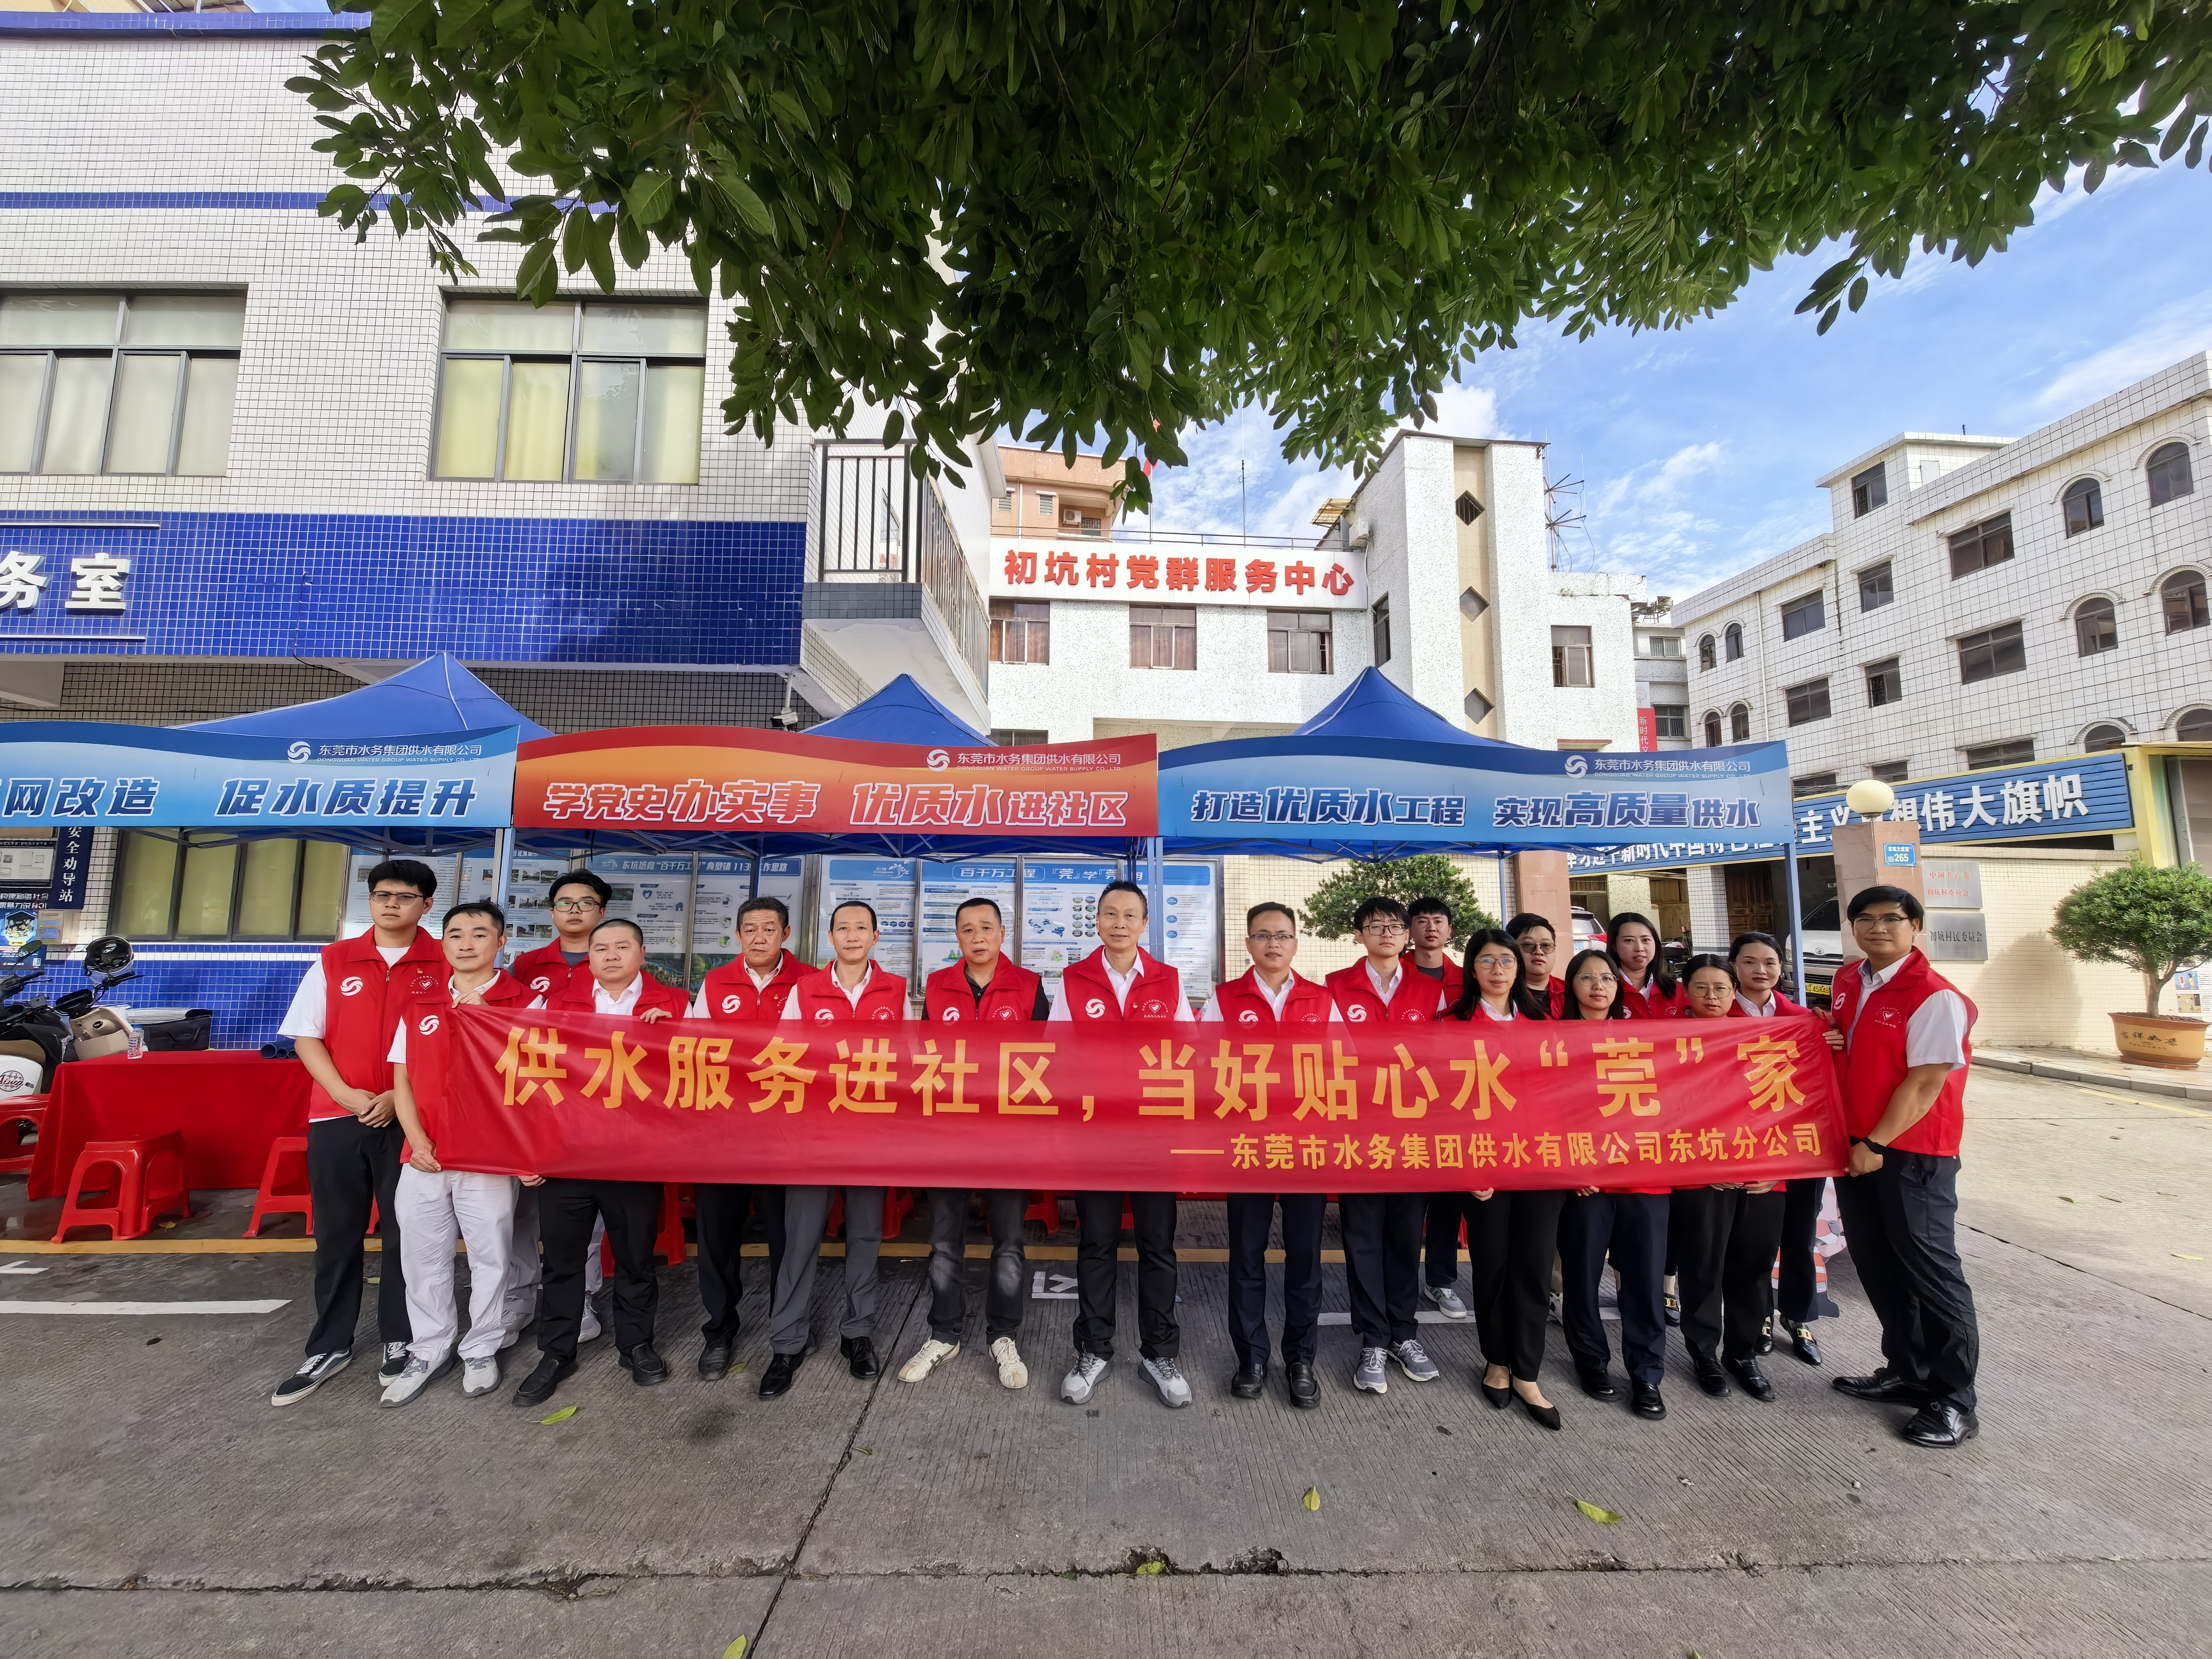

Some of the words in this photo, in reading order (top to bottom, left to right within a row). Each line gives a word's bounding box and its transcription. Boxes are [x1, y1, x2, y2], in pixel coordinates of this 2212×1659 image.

[1005, 550, 1354, 596] 初坑村党群服务中心
[319, 745, 482, 756] 东莞市水务集团供水有限公司
[957, 753, 1121, 765] 东莞市水务集团供水有限公司
[1594, 759, 1750, 772] 东莞市水务集团供水有限公司
[214, 778, 477, 818] 促水质提升
[544, 779, 821, 824] 学党史办实事
[849, 782, 1128, 826] 优质水进社区
[1191, 786, 1466, 827] 打造优质水工程
[1493, 790, 1761, 829] 实现高质量供水
[59, 826, 82, 902] 安全劝导站
[1894, 853, 1909, 862] 265
